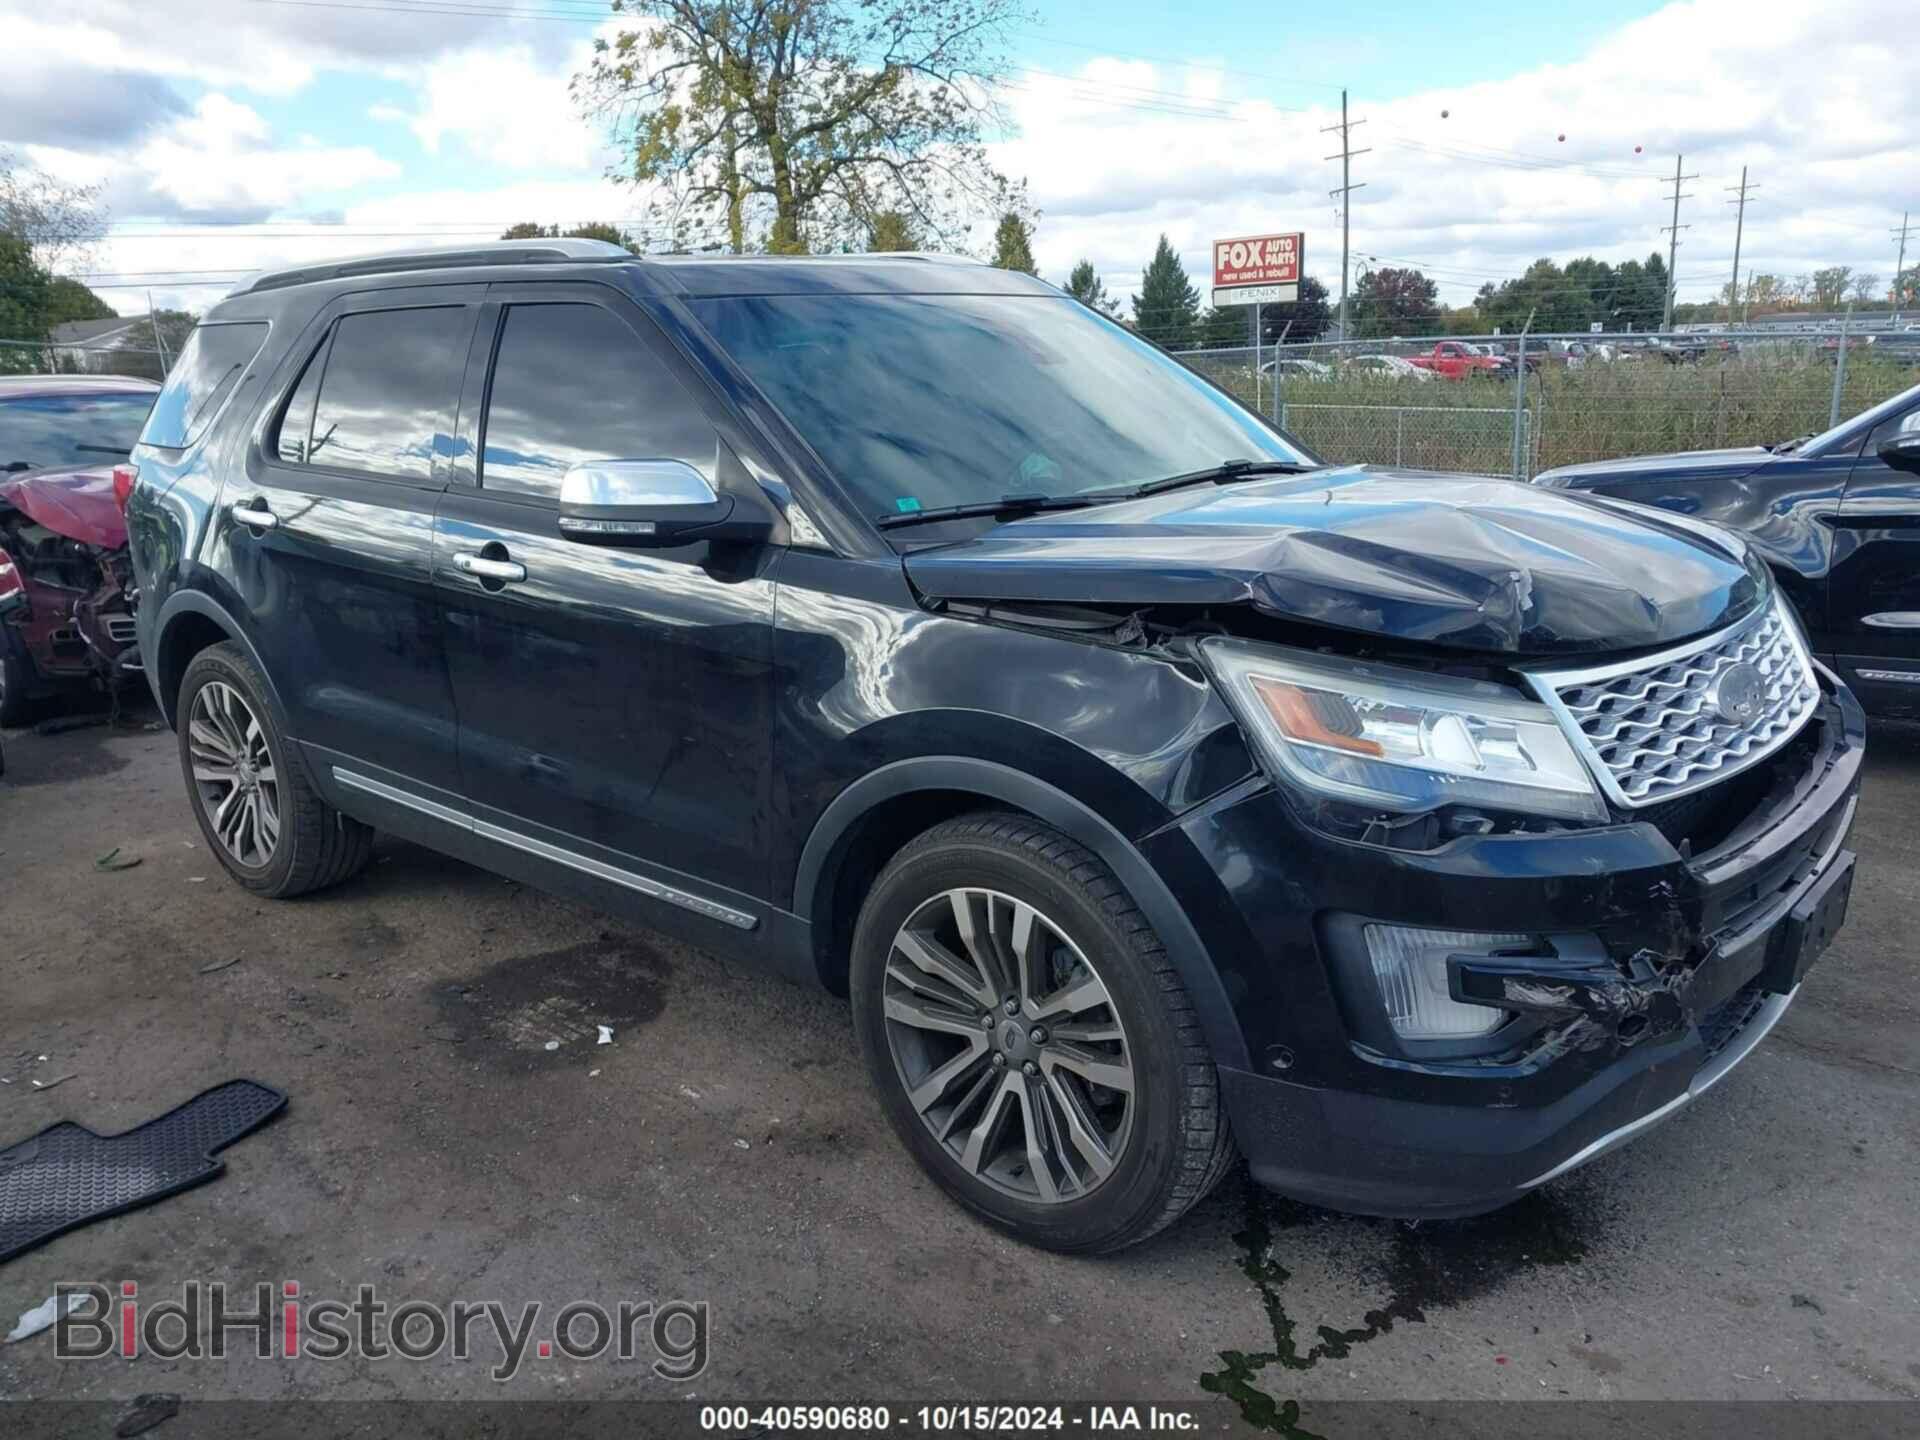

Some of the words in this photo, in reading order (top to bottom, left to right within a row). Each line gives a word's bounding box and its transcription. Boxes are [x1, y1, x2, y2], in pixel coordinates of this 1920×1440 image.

[1265, 238, 1293, 253] AUTO
[1217, 241, 1263, 270] FOX
[1264, 252, 1295, 266] PARTS
[1222, 272, 1238, 280] new
[1239, 269, 1257, 279] used
